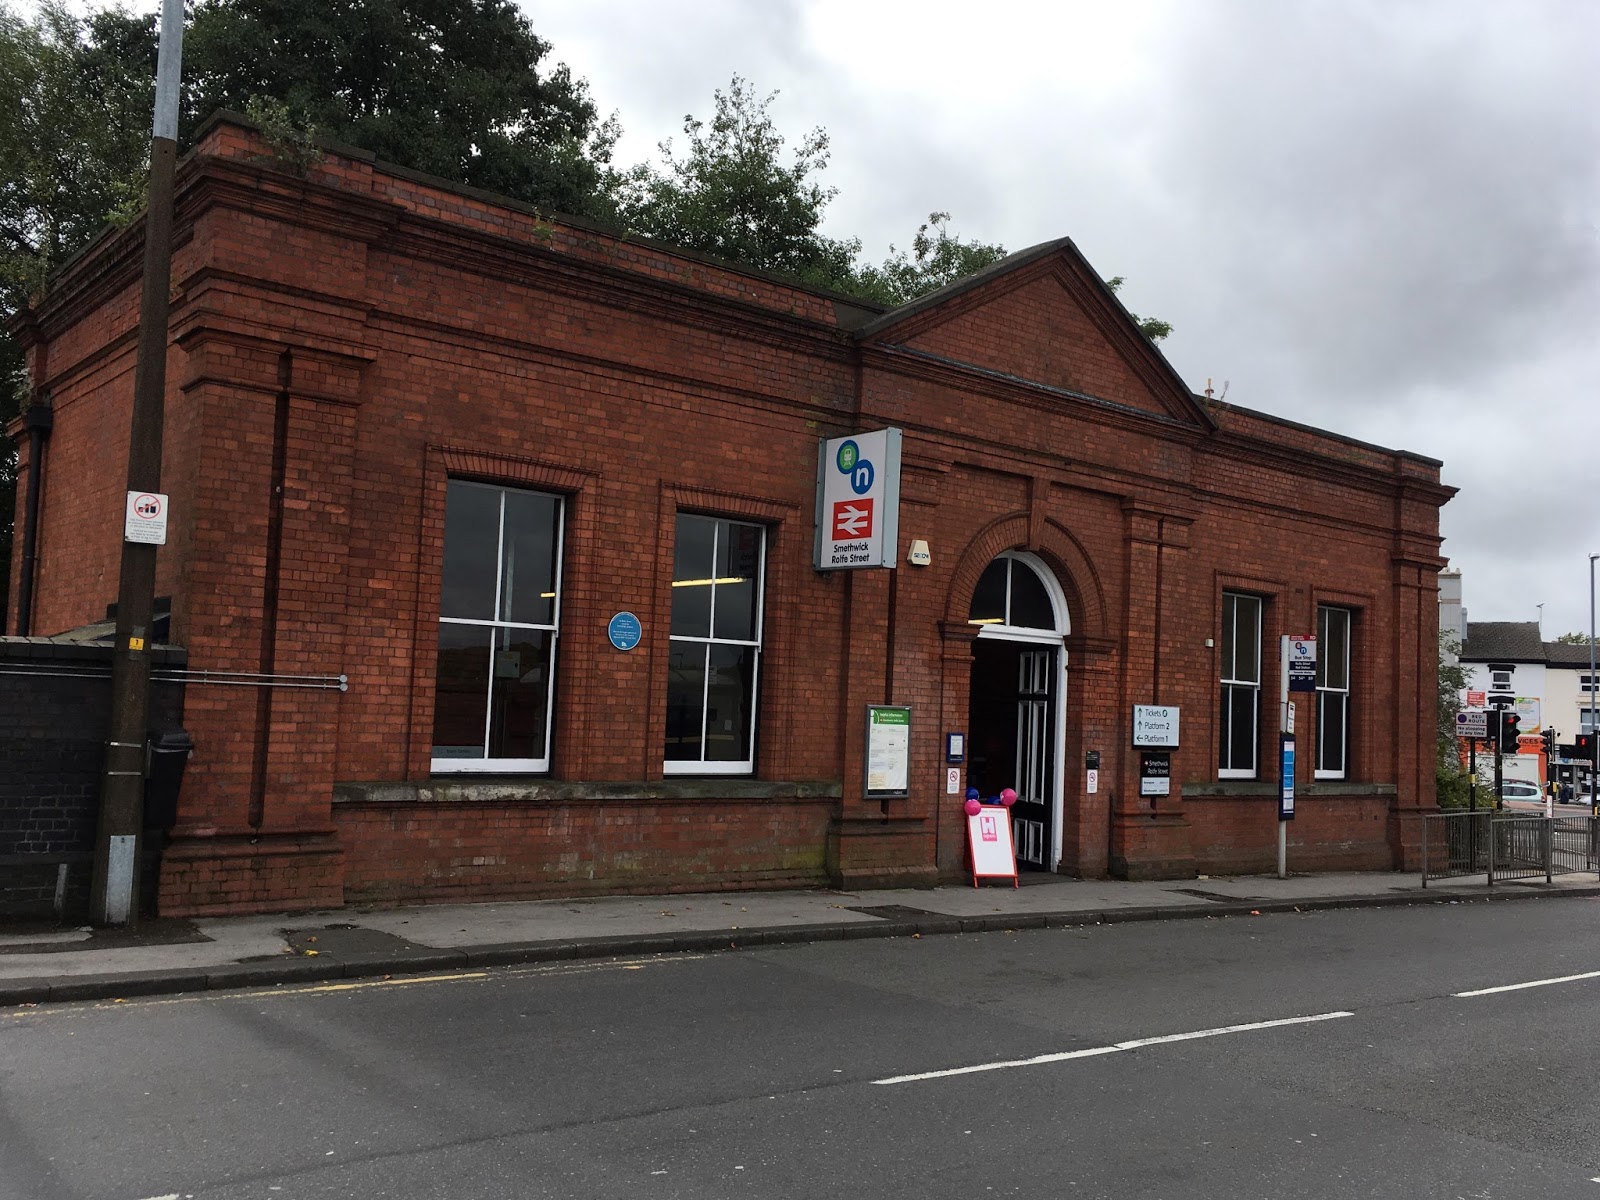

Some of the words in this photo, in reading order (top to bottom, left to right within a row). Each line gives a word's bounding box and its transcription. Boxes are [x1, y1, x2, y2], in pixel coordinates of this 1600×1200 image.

[833, 541, 869, 553] Smethwick
[831, 554, 848, 564] Rolfe
[849, 553, 870, 563] Street
[1145, 709, 1162, 717] Tickets
[1144, 722, 1165, 730] Platform
[1166, 722, 1170, 730] 2
[1144, 735, 1165, 743] Platform
[1148, 759, 1169, 767] Smethwick
